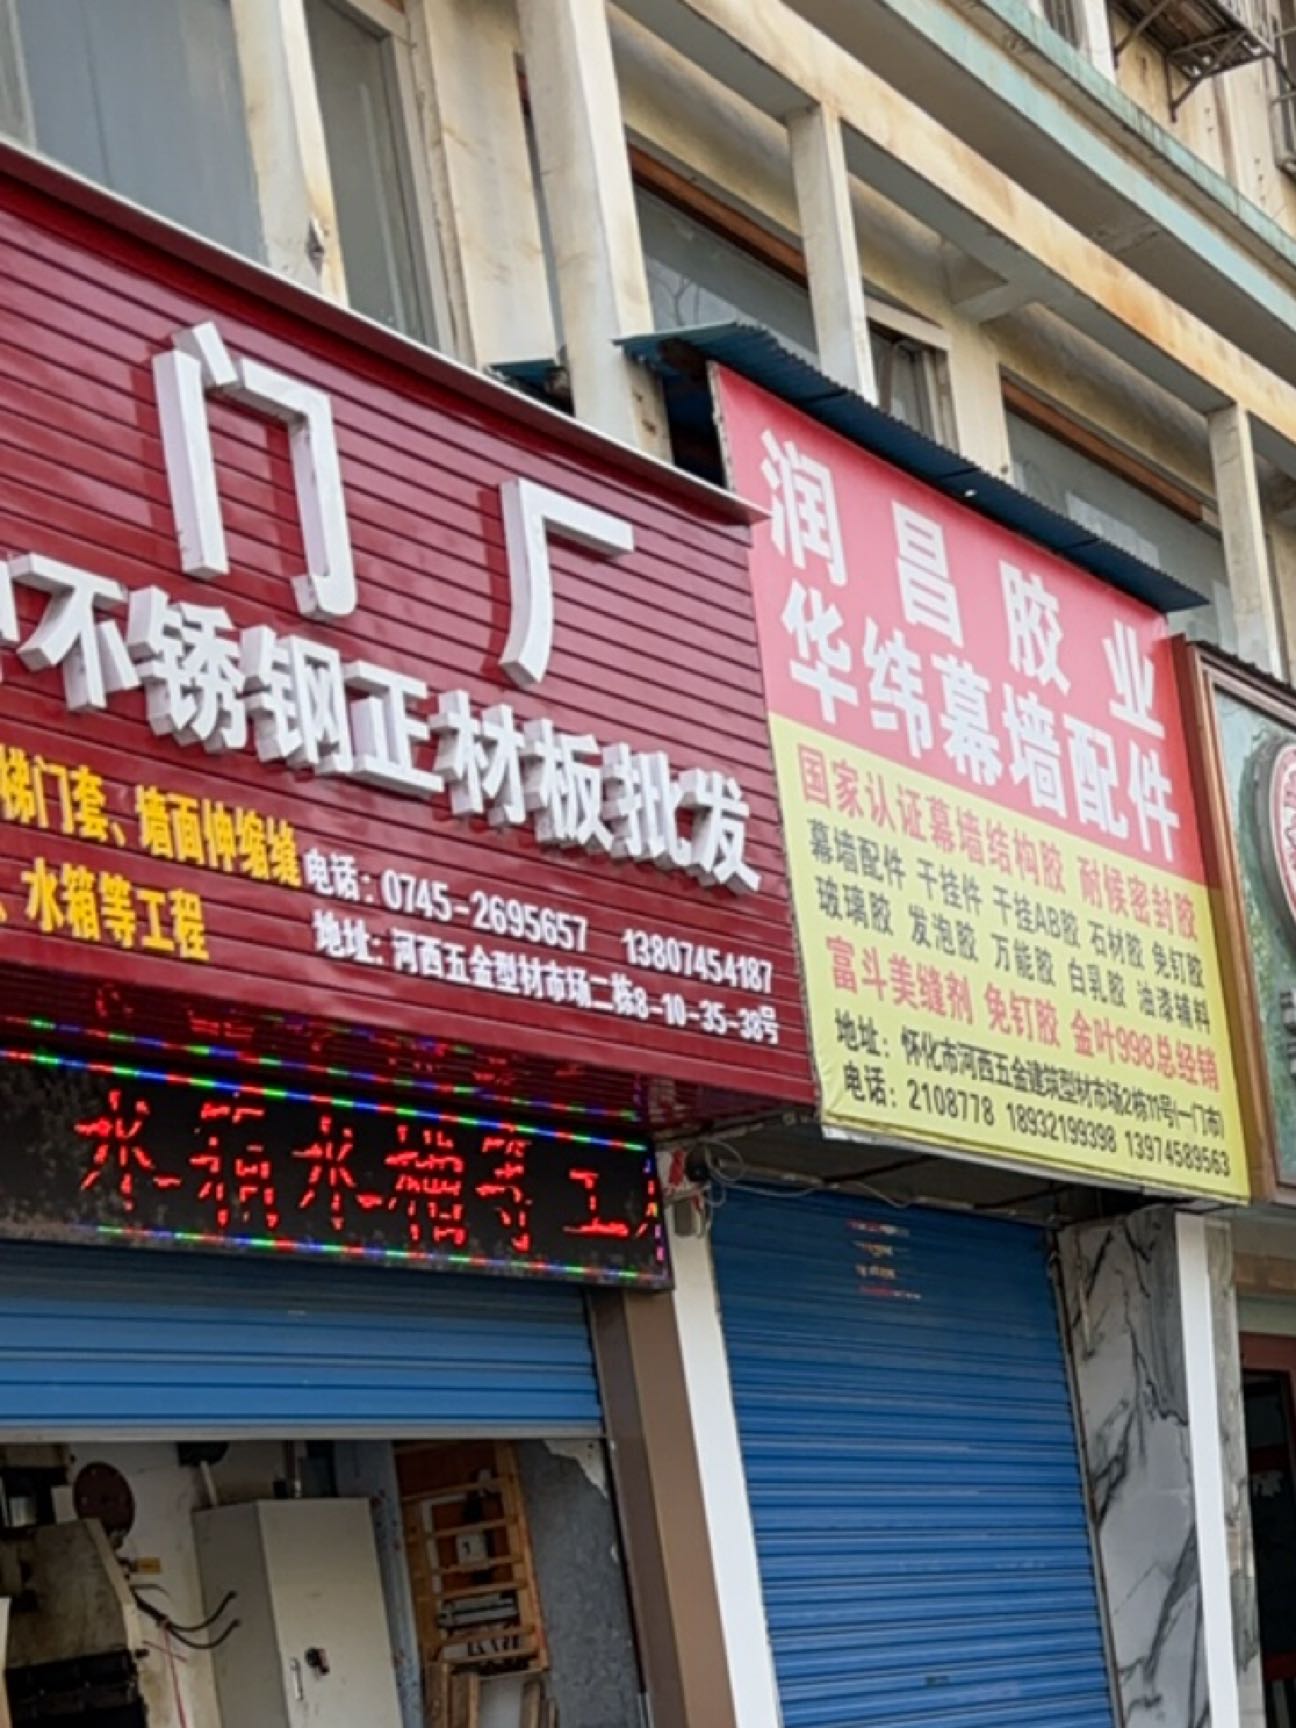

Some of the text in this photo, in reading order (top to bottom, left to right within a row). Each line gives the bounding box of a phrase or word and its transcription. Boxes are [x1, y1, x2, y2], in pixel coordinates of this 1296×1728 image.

[761, 429, 1164, 739] 润昌胶业
[0, 552, 760, 895] 不锈钢正材板批发
[781, 580, 1180, 864] 华纬幕墙配件
[797, 742, 1066, 894] 国家认证幕墙结构胶
[621, 928, 773, 993] 13807454187
[807, 818, 1205, 989] 幕墙配件 干挂件 干挂AB胶 石材胶 免钉胶
[815, 875, 894, 936] 玻璃胶
[908, 903, 979, 963] 发泡胶
[991, 934, 1056, 987] 万能胶
[1067, 957, 1126, 1008] 白乳胶
[826, 935, 1220, 1093] 富斗美缝剂 免钉胶 金叶998总经销
[1006, 1101, 1117, 1154] 18932199398
[1124, 1130, 1231, 1178] 13974589563
